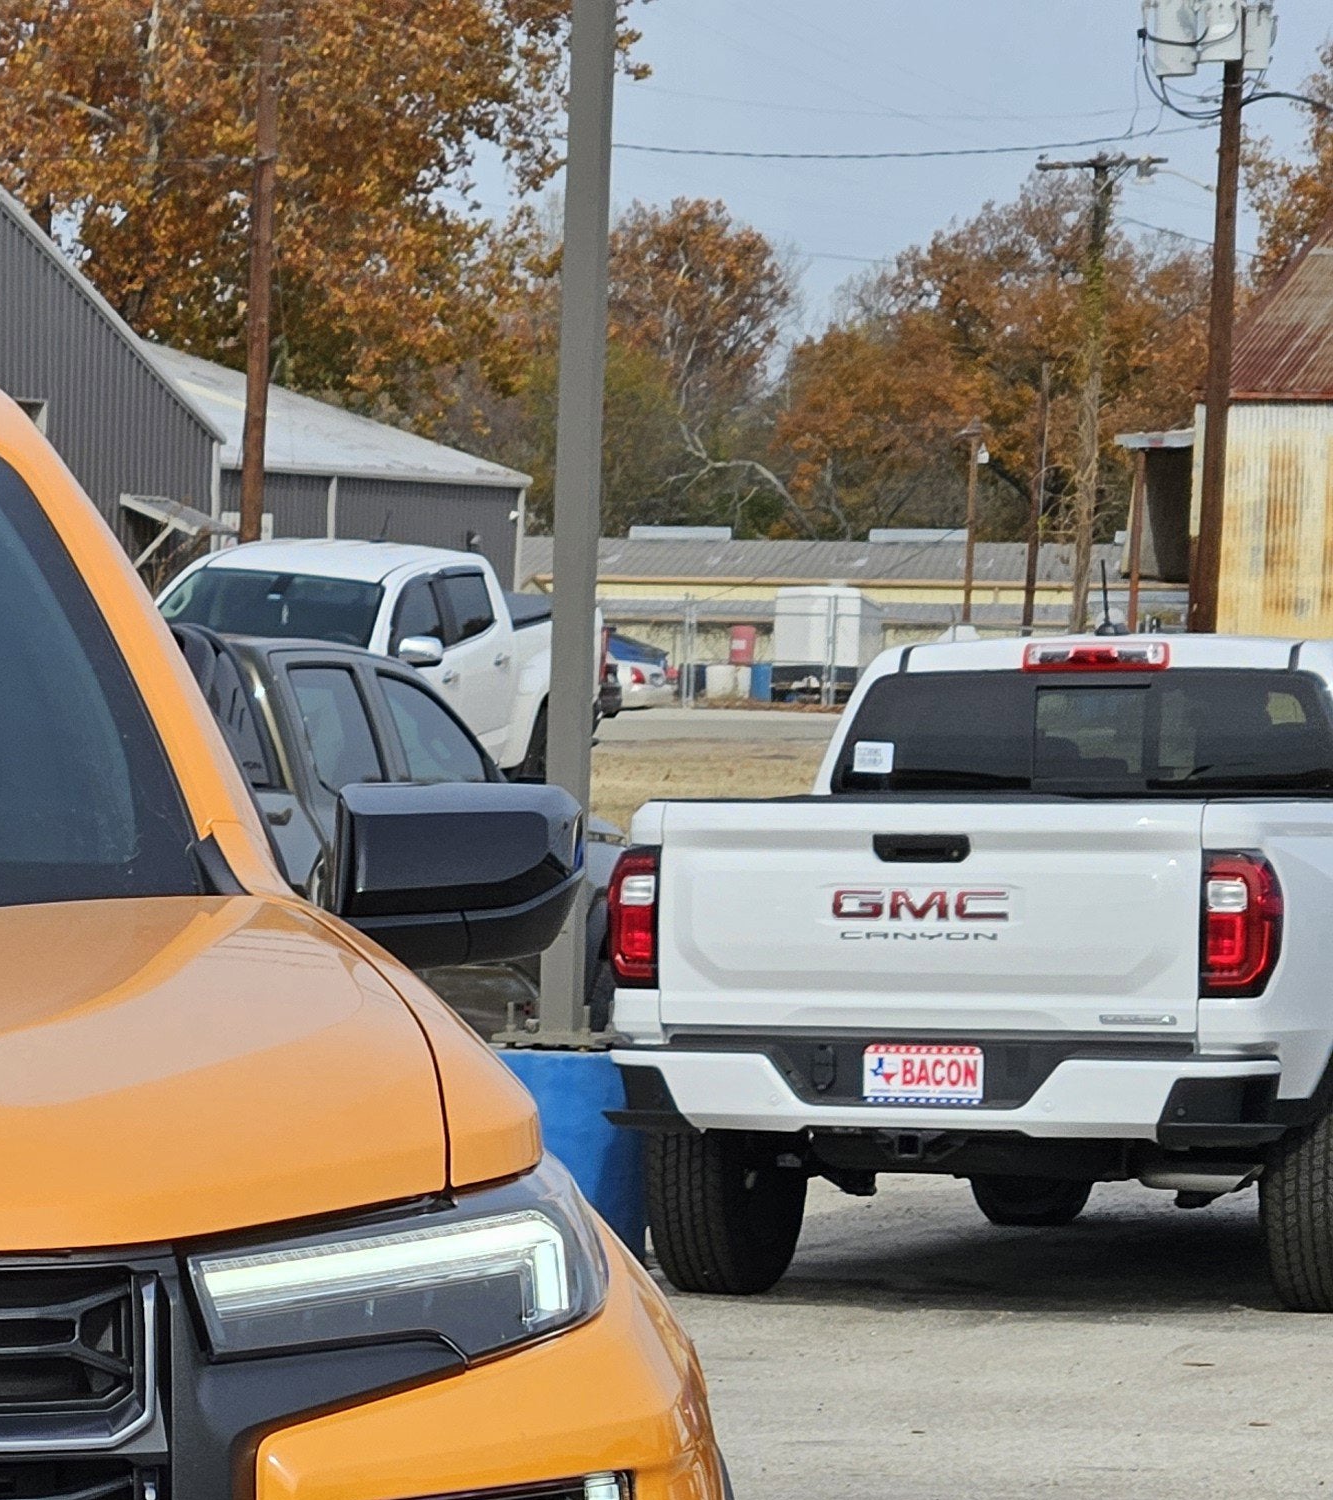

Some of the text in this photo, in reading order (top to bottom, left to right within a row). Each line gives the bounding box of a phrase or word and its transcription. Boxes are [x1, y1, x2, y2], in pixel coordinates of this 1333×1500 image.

[831, 887, 1010, 922] GMC
[840, 930, 999, 941] CANYON
[901, 1058, 979, 1087] BACON
